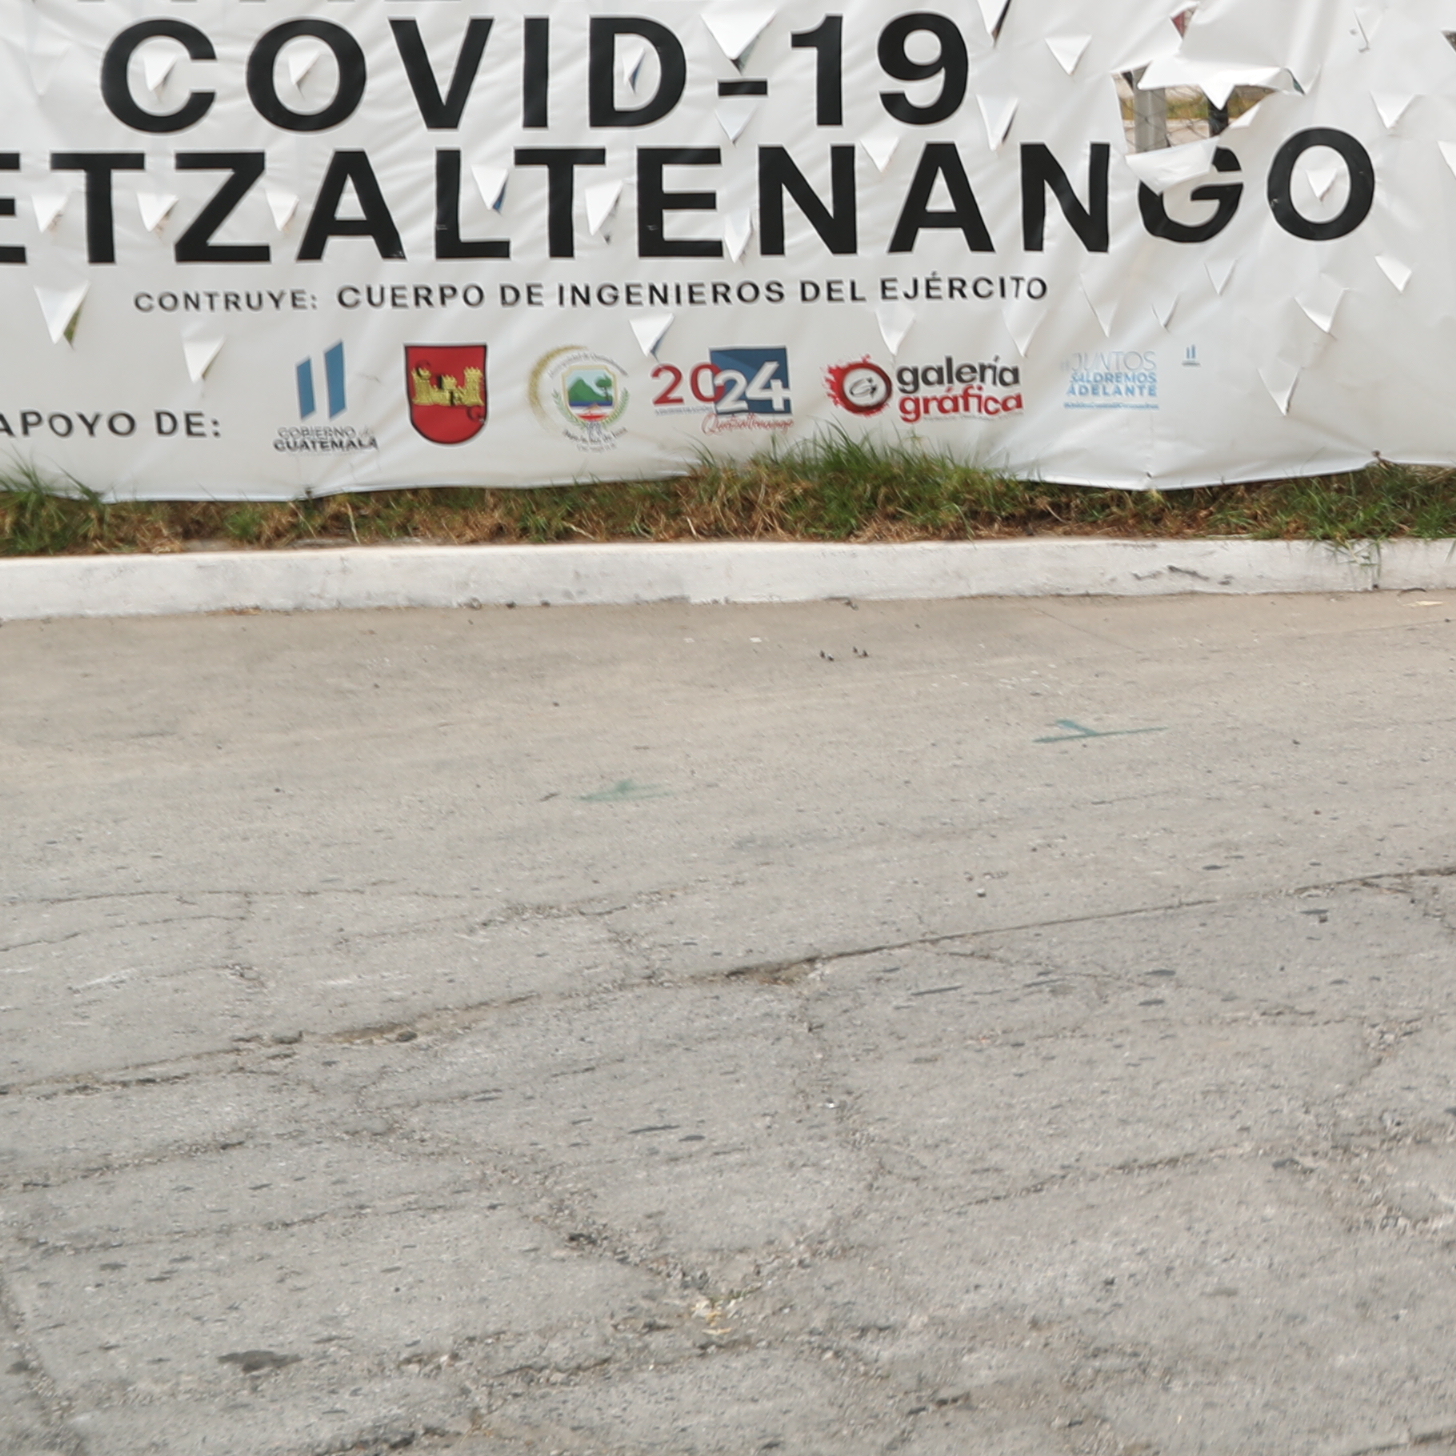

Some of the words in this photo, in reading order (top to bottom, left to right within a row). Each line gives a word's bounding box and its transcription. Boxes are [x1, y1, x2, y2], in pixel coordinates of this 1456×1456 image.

[101, 12, 969, 133] COVID-19
[134, 288, 319, 313] CONTRUYE:
[337, 285, 484, 308] CUERPO
[500, 284, 542, 306] DE
[559, 281, 784, 306] INGENIEROS
[800, 280, 866, 302] DEL
[881, 272, 1047, 300] EJÉRCITO
[650, 360, 792, 412] 2024
[896, 355, 1020, 394] galería
[1066, 384, 1158, 397] ADELANTE
[899, 385, 1023, 423] gráfica
[155, 410, 222, 438] DE:
